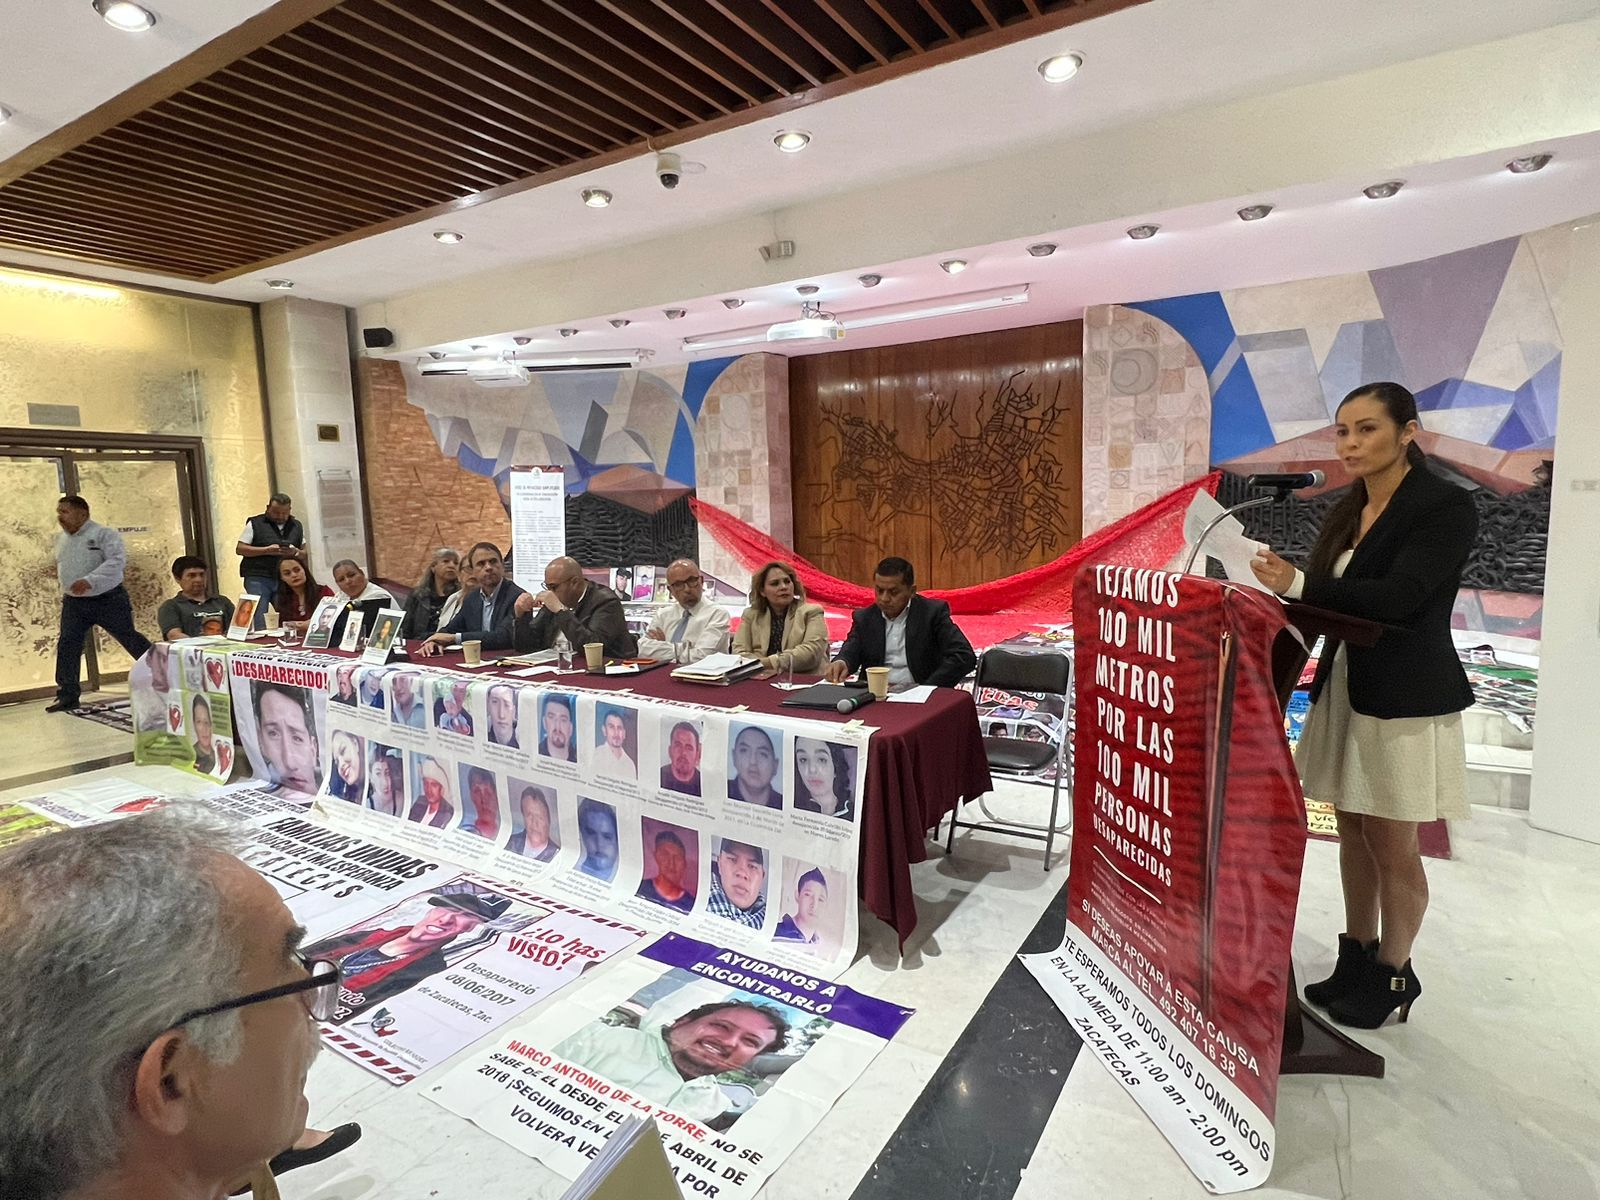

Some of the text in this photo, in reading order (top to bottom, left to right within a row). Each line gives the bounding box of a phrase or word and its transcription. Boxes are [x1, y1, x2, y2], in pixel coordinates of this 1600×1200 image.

[1096, 565, 1182, 607] TEJAMOS
[1098, 607, 1176, 662] 100 MIL
[232, 660, 328, 689] ¡DESAPARECIDO!
[1096, 653, 1174, 714] METROS
[1097, 696, 1174, 764] POR LAS
[1098, 740, 1173, 818] 100 MIL
[262, 816, 362, 853] FAMILIAS
[341, 843, 439, 880] UNIDAS
[1093, 812, 1172, 887] DESAPARECIDAS
[1094, 781, 1172, 857] PERSONAS
[324, 860, 405, 891] ESPERANZA
[521, 928, 606, 958] ¿Lo has
[716, 951, 819, 991] AYUDANOS
[819, 986, 837, 997] A
[417, 986, 494, 1024] de Zacatecas, Zac.
[445, 974, 517, 1006] 08/06/2017
[463, 962, 540, 995] Desapareció
[690, 961, 833, 1014] ENCONTRARLO
[1082, 898, 1091, 914] SI
[1091, 908, 1122, 948] DESEAS
[1124, 939, 1164, 988] APOYAR
[1164, 983, 1174, 997] A
[1175, 989, 1205, 1028] ESTA
[1207, 1017, 1260, 1077] CAUSA
[1091, 926, 1236, 1078] MARCA AL TEL. 492 407 16 38
[1050, 956, 1069, 971] EN
[1063, 967, 1080, 983] LA
[1073, 983, 1124, 1032] ALAMEDA
[1117, 1031, 1140, 1051] DE
[1135, 1051, 1168, 1083] 11:00
[1162, 1083, 1186, 1105] am
[1189, 1114, 1226, 1147] 2:00
[1216, 1149, 1249, 1177] pm
[1065, 936, 1076, 954] TE
[1075, 949, 1130, 1011] ESPERAMOS
[1131, 1005, 1167, 1050] TODOS
[1169, 1044, 1194, 1079] LOS
[1195, 1072, 1270, 1162] DOMINGOS
[1074, 1016, 1140, 1087] ZACATECAS
[477, 1064, 511, 1083] 2018
[581, 1120, 606, 1134] EN
[681, 1172, 721, 1199] POR
[489, 1052, 748, 1186] SABE DE EL DESDE EL E ABRIL DE
[507, 1040, 764, 1165] MARCO ANTONIO DE LA TORRE, NO SE
[577, 1141, 600, 1160] VE
